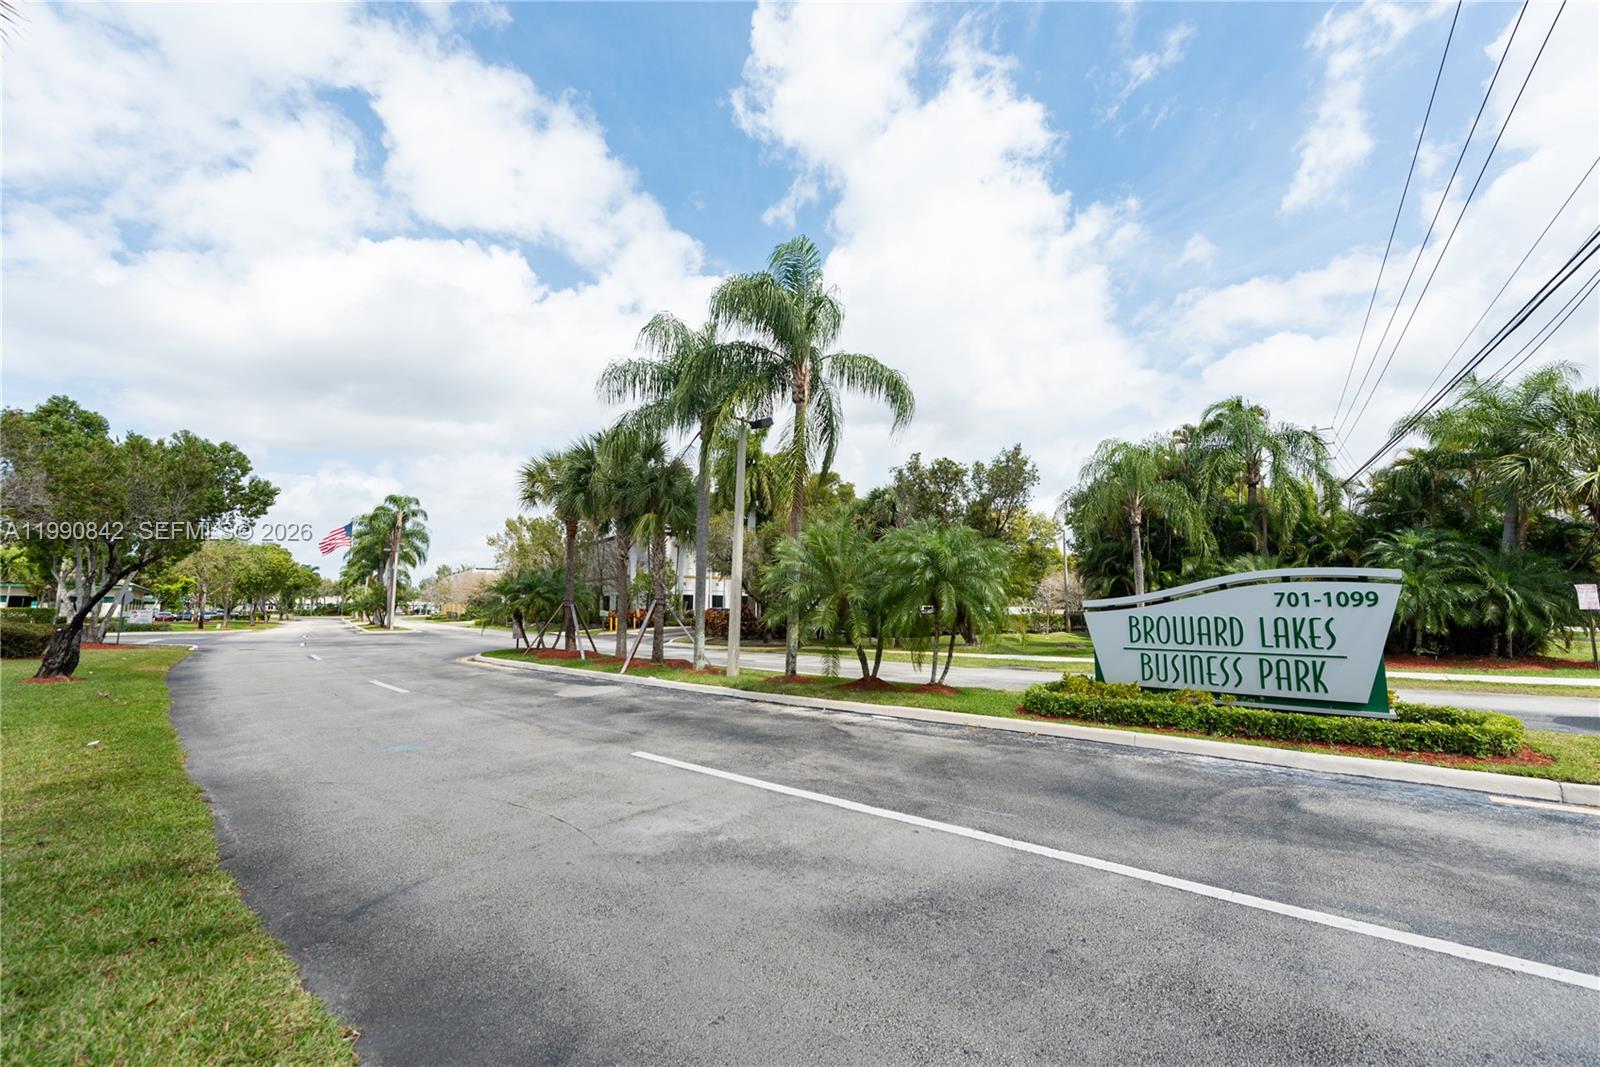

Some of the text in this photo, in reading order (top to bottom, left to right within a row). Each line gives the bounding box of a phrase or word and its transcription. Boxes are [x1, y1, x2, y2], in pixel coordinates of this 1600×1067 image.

[1274, 591, 1379, 607] 701-1099
[1128, 615, 1337, 650] BROWARD LAKES
[1140, 653, 1329, 693] BUSINESS PARK
